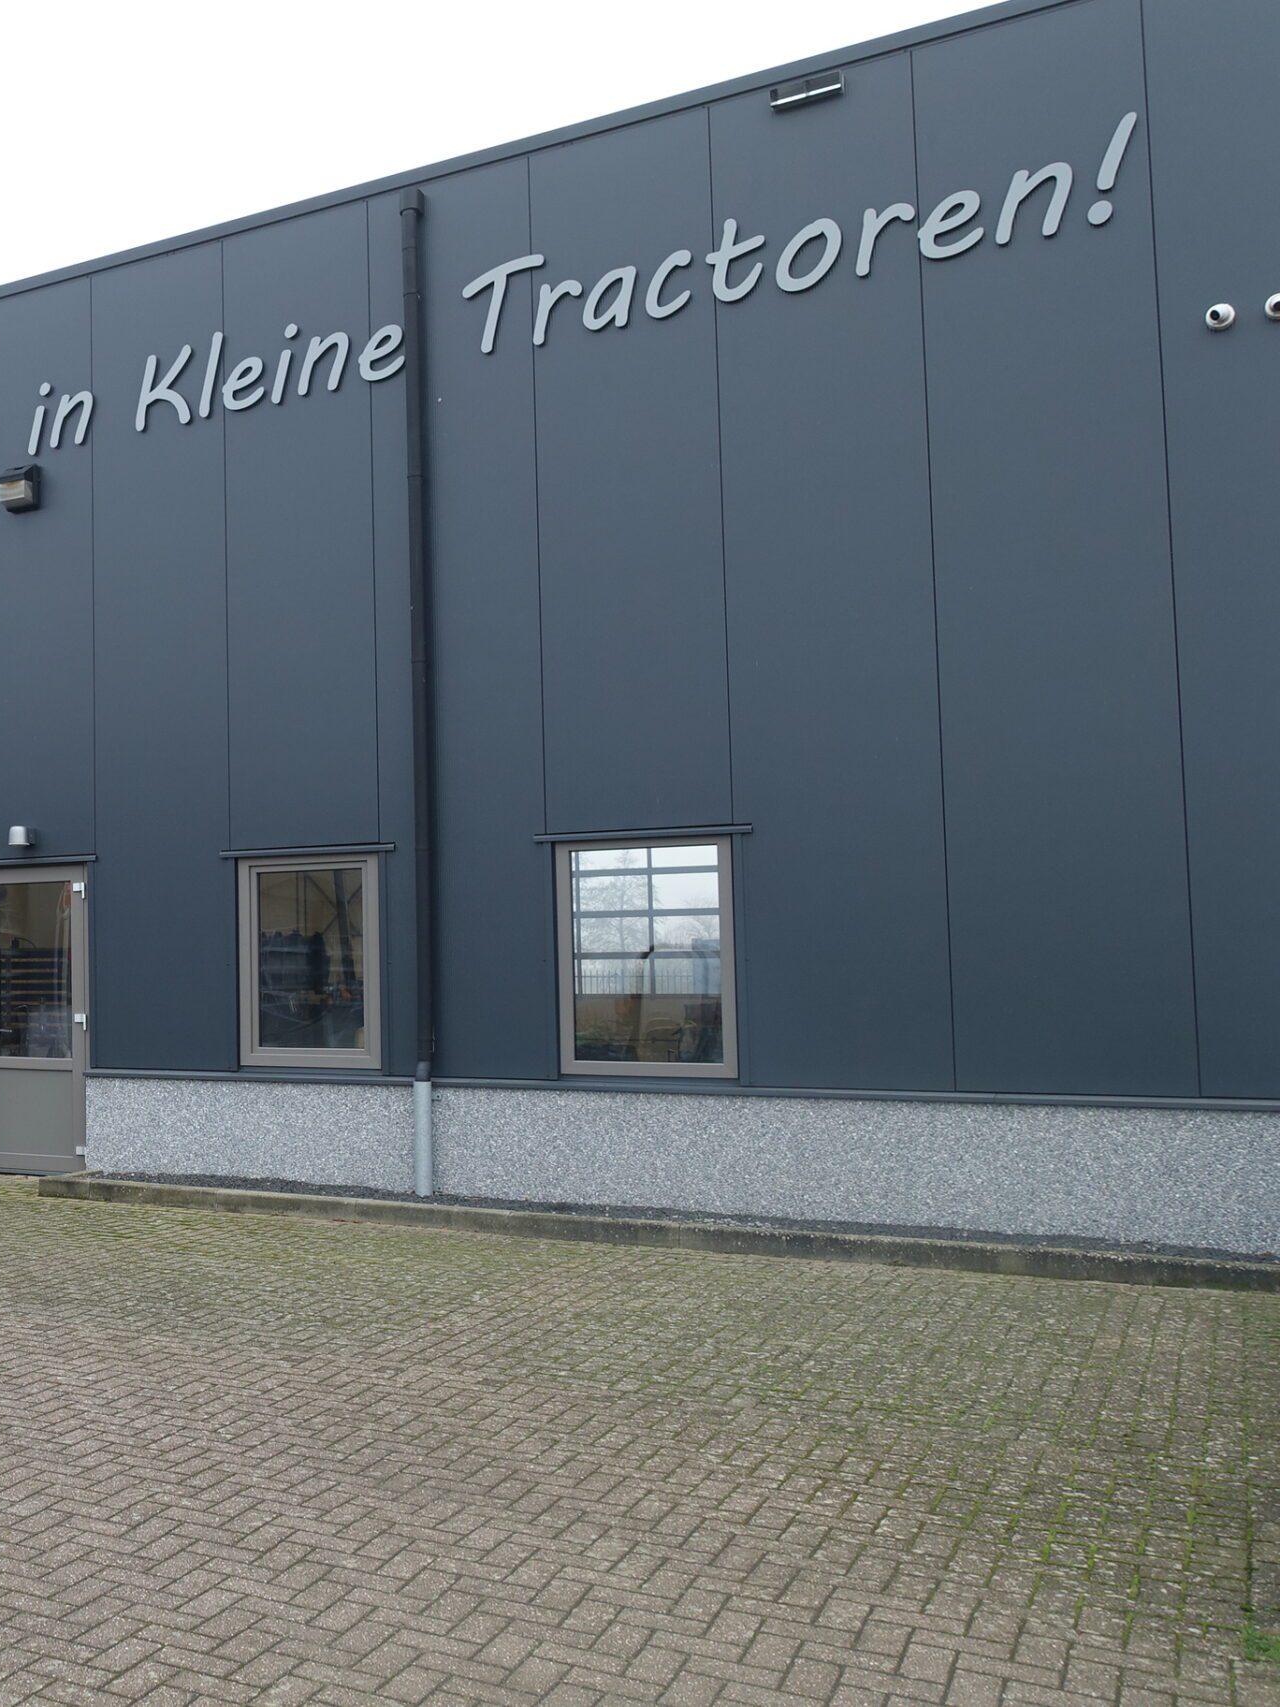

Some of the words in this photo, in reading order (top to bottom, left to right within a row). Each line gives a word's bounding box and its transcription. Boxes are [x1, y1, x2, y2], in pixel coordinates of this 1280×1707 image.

[27, 381, 94, 456] in
[135, 323, 406, 432] Kleine
[461, 111, 1138, 354] Tractoren!
